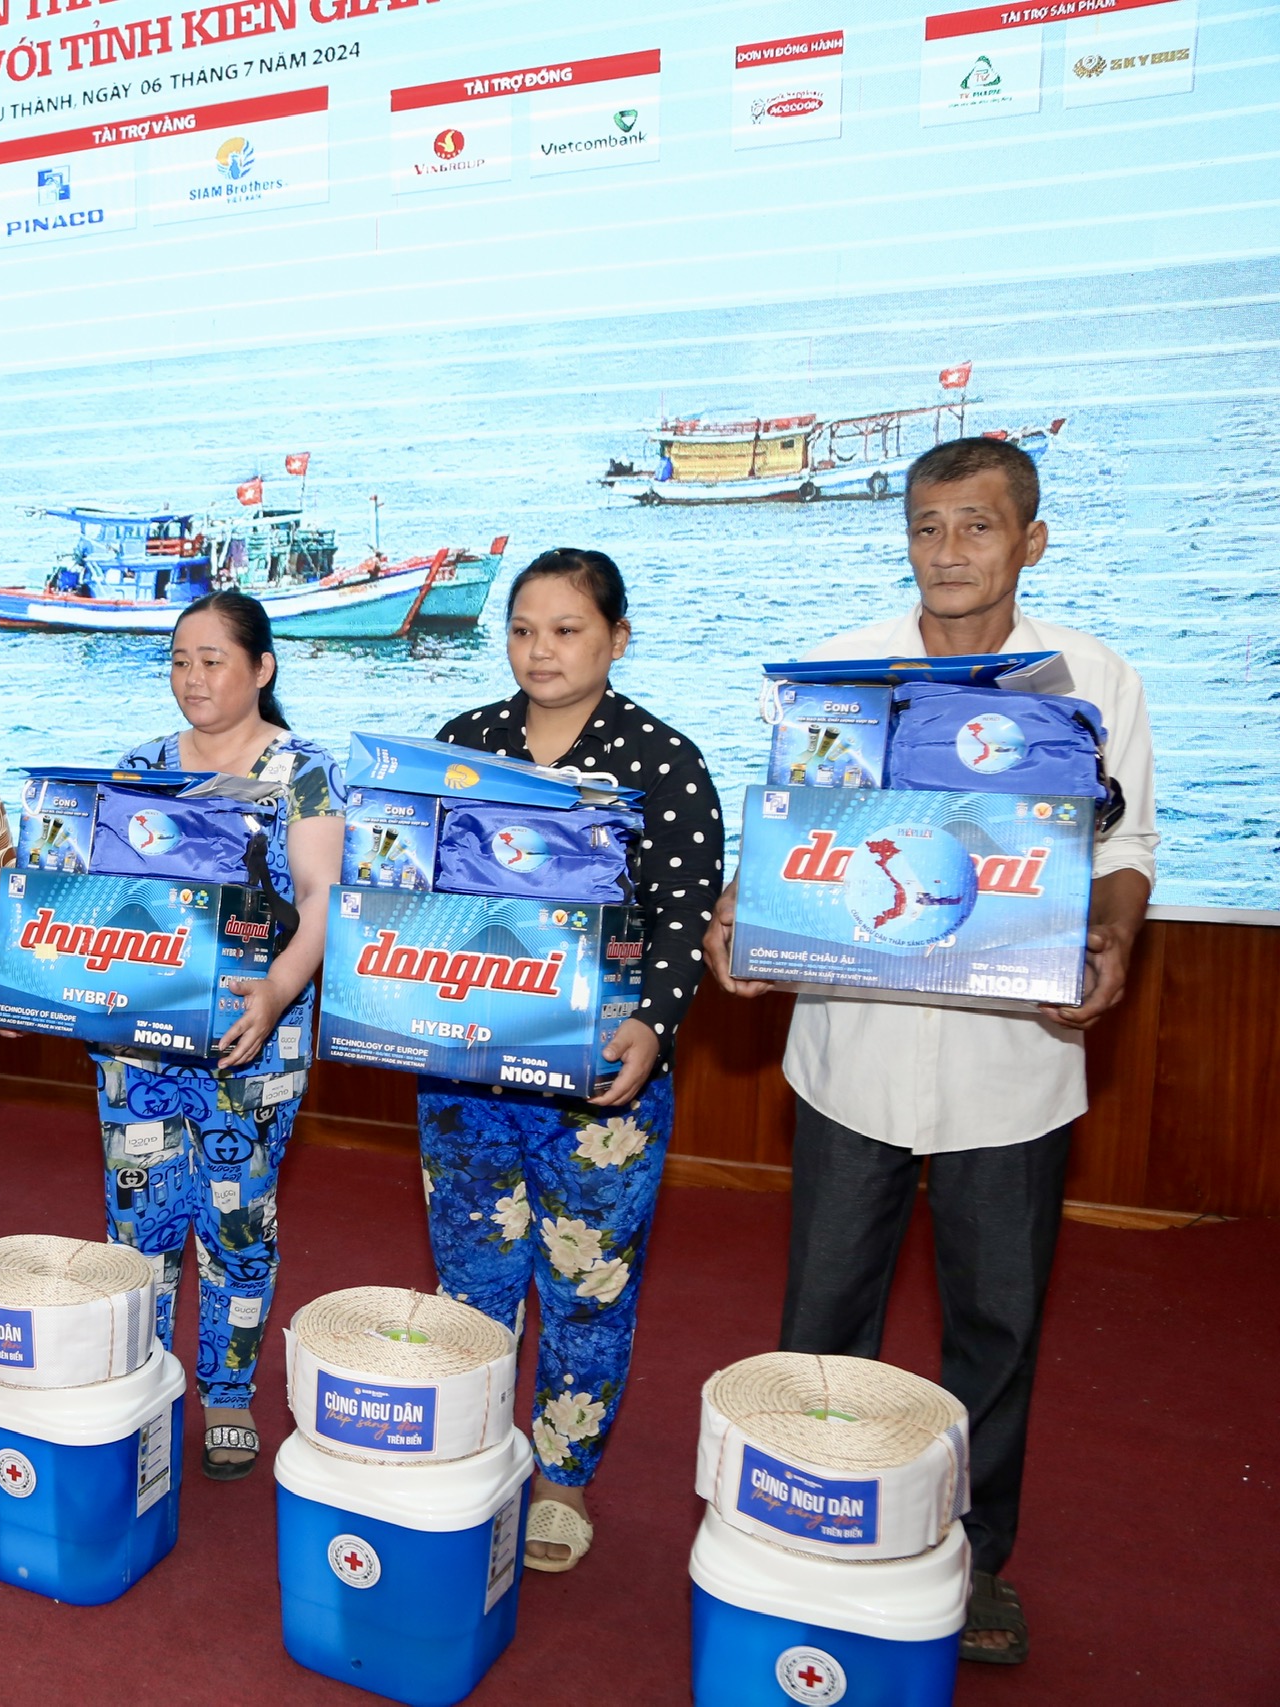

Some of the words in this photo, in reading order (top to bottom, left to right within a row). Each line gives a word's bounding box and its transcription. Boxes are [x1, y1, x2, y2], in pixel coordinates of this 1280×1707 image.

[60, 20, 173, 73] TỈNH
[82, 81, 133, 107] NGÀY
[140, 76, 163, 96] 06
[170, 63, 239, 90] THÁNG
[243, 60, 254, 78] 7
[259, 50, 308, 75] NĂM
[313, 42, 362, 67] 2024
[464, 77, 491, 97] TÀI
[492, 73, 523, 94] TRỢ
[93, 128, 117, 145] TÀI
[118, 121, 151, 142] TRỢ
[152, 112, 197, 135] VÀNG
[540, 131, 649, 157] Vietcombank
[189, 185, 222, 201] SIAM
[226, 179, 283, 196] Brothers
[7, 208, 105, 238] PINACO
[20, 908, 190, 974] dongnai
[355, 929, 568, 1002] dongnai
[750, 947, 778, 959] CÔNG
[781, 950, 808, 962] NGHỆ
[810, 952, 838, 964] CHÂU
[39, 1010, 49, 1018] OF
[50, 1012, 77, 1022] EUROPE
[136, 1020, 147, 1028] 12V
[152, 1021, 173, 1031] 100Ah
[133, 1029, 172, 1047] N100
[331, 1036, 383, 1051] TECHNOLOGY
[384, 1043, 396, 1052] OF
[397, 1046, 429, 1057] EUROPE
[356, 1053, 378, 1061] BATTERY
[403, 1060, 425, 1068] VIETNAM
[502, 1054, 517, 1064] 12V
[522, 1057, 548, 1067] 100Ah
[500, 1065, 547, 1086] N100
[324, 1391, 358, 1416] CÙNG
[361, 1402, 390, 1421] NGƯ
[393, 1402, 423, 1423] DÂN
[386, 1434, 405, 1445] TRÊN
[406, 1432, 422, 1445] BIỂN
[751, 1467, 789, 1502] CÙNG
[791, 1486, 827, 1515] NGƯ
[827, 1495, 864, 1518] DÂN
[820, 1525, 843, 1539] TRÊN
[843, 1525, 863, 1539] BIỂN
